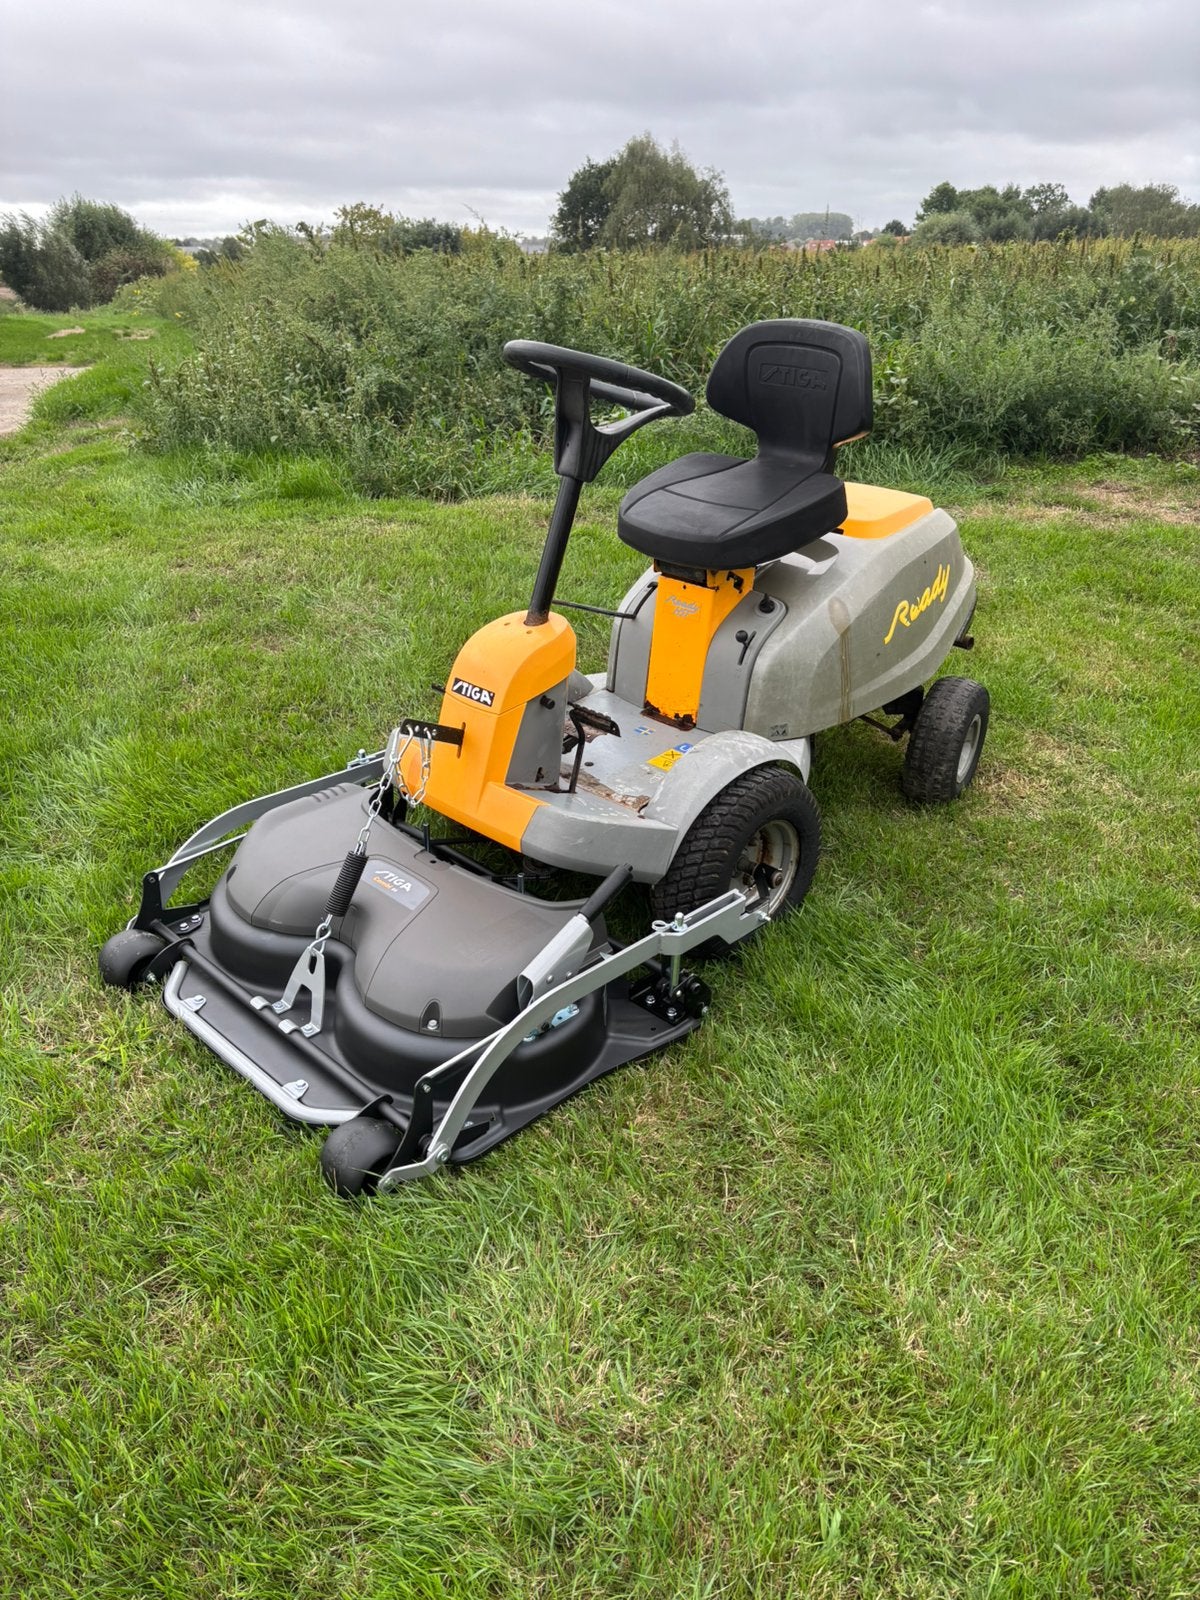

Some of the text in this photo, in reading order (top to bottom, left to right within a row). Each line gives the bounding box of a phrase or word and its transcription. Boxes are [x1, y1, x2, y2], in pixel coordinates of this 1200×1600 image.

[761, 366, 826, 390] STIGA
[884, 563, 950, 645] Ready
[452, 681, 492, 706] STIGA
[374, 870, 412, 892] STIGA
